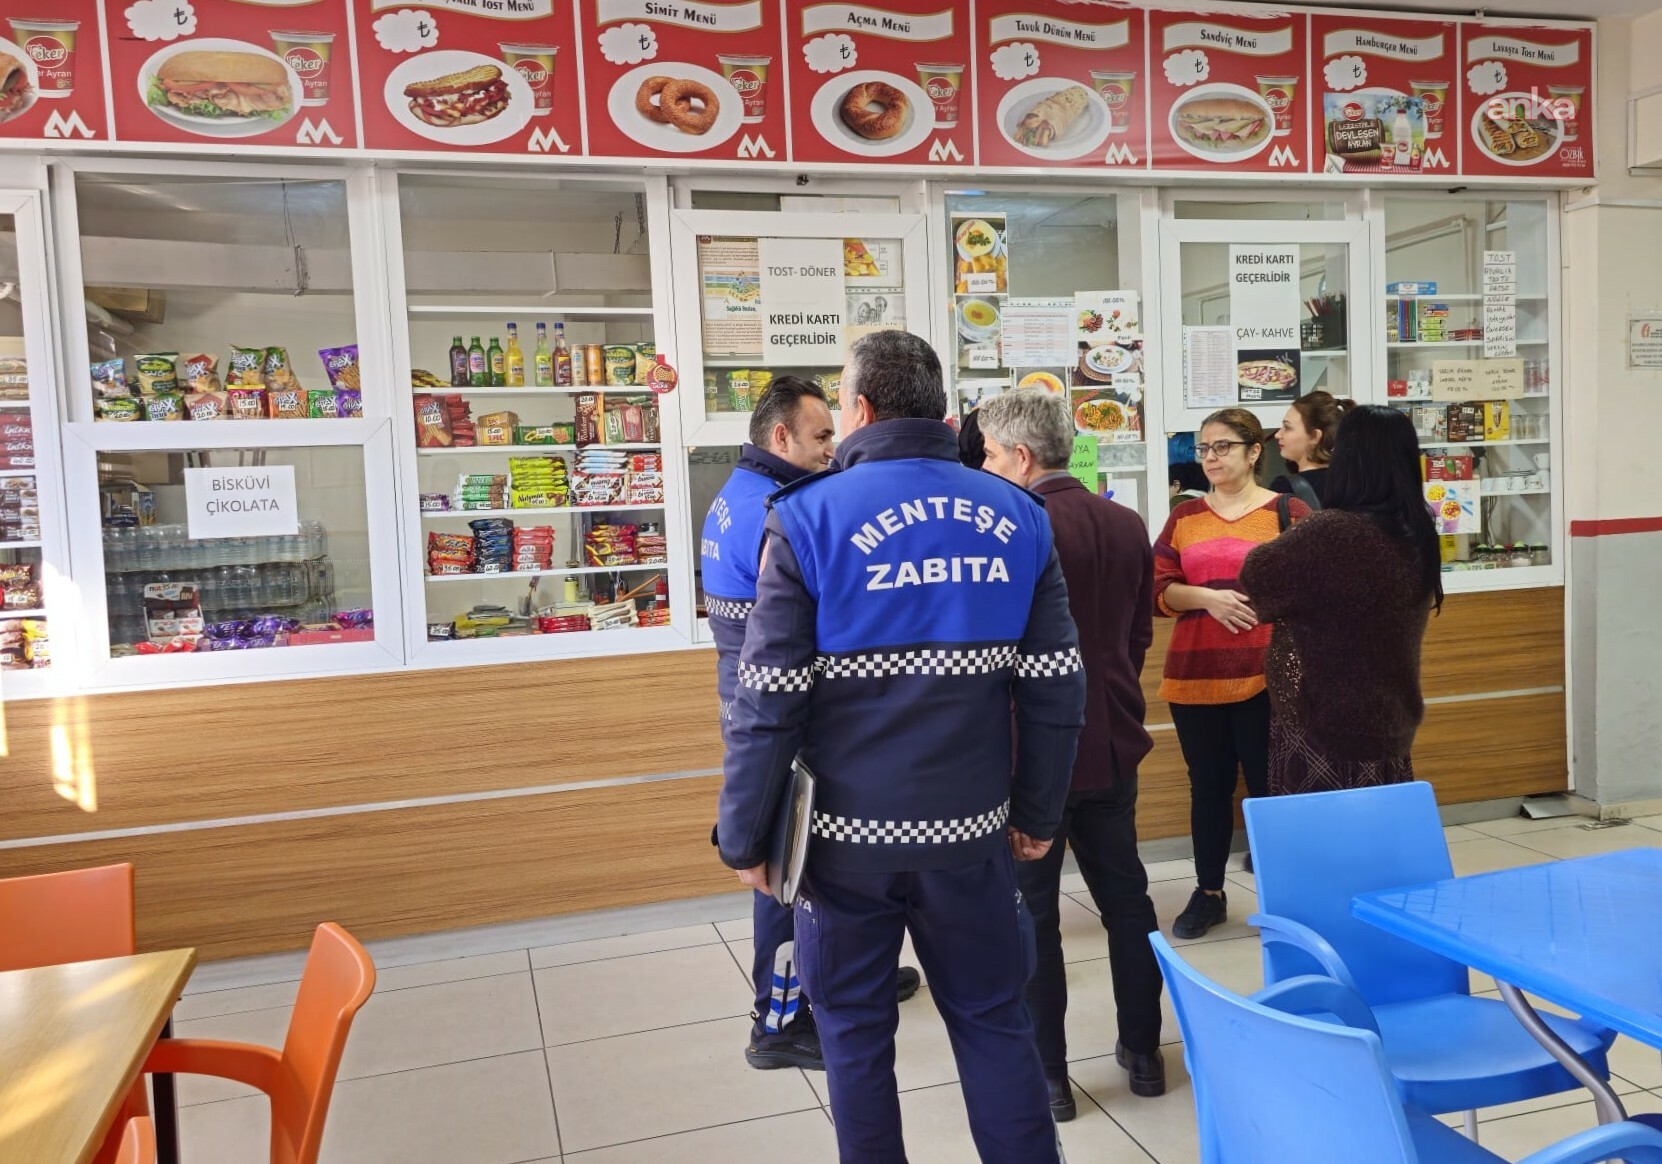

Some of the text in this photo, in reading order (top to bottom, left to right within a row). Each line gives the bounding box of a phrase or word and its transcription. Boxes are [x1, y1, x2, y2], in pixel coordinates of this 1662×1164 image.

[1236, 253, 1294, 264] KREDİ KARTI
[800, 265, 836, 277] DÖNER
[1235, 271, 1291, 284] GEÇERLİDİR
[769, 313, 840, 325] KREDİ KARTI
[1262, 328, 1294, 339] KAHVE
[770, 334, 837, 347] GEÇERLİDİR
[212, 475, 271, 491] BİSKÜVİ
[206, 498, 280, 516] ÇİKOLATA
[850, 496, 1018, 555] MENTEŞE
